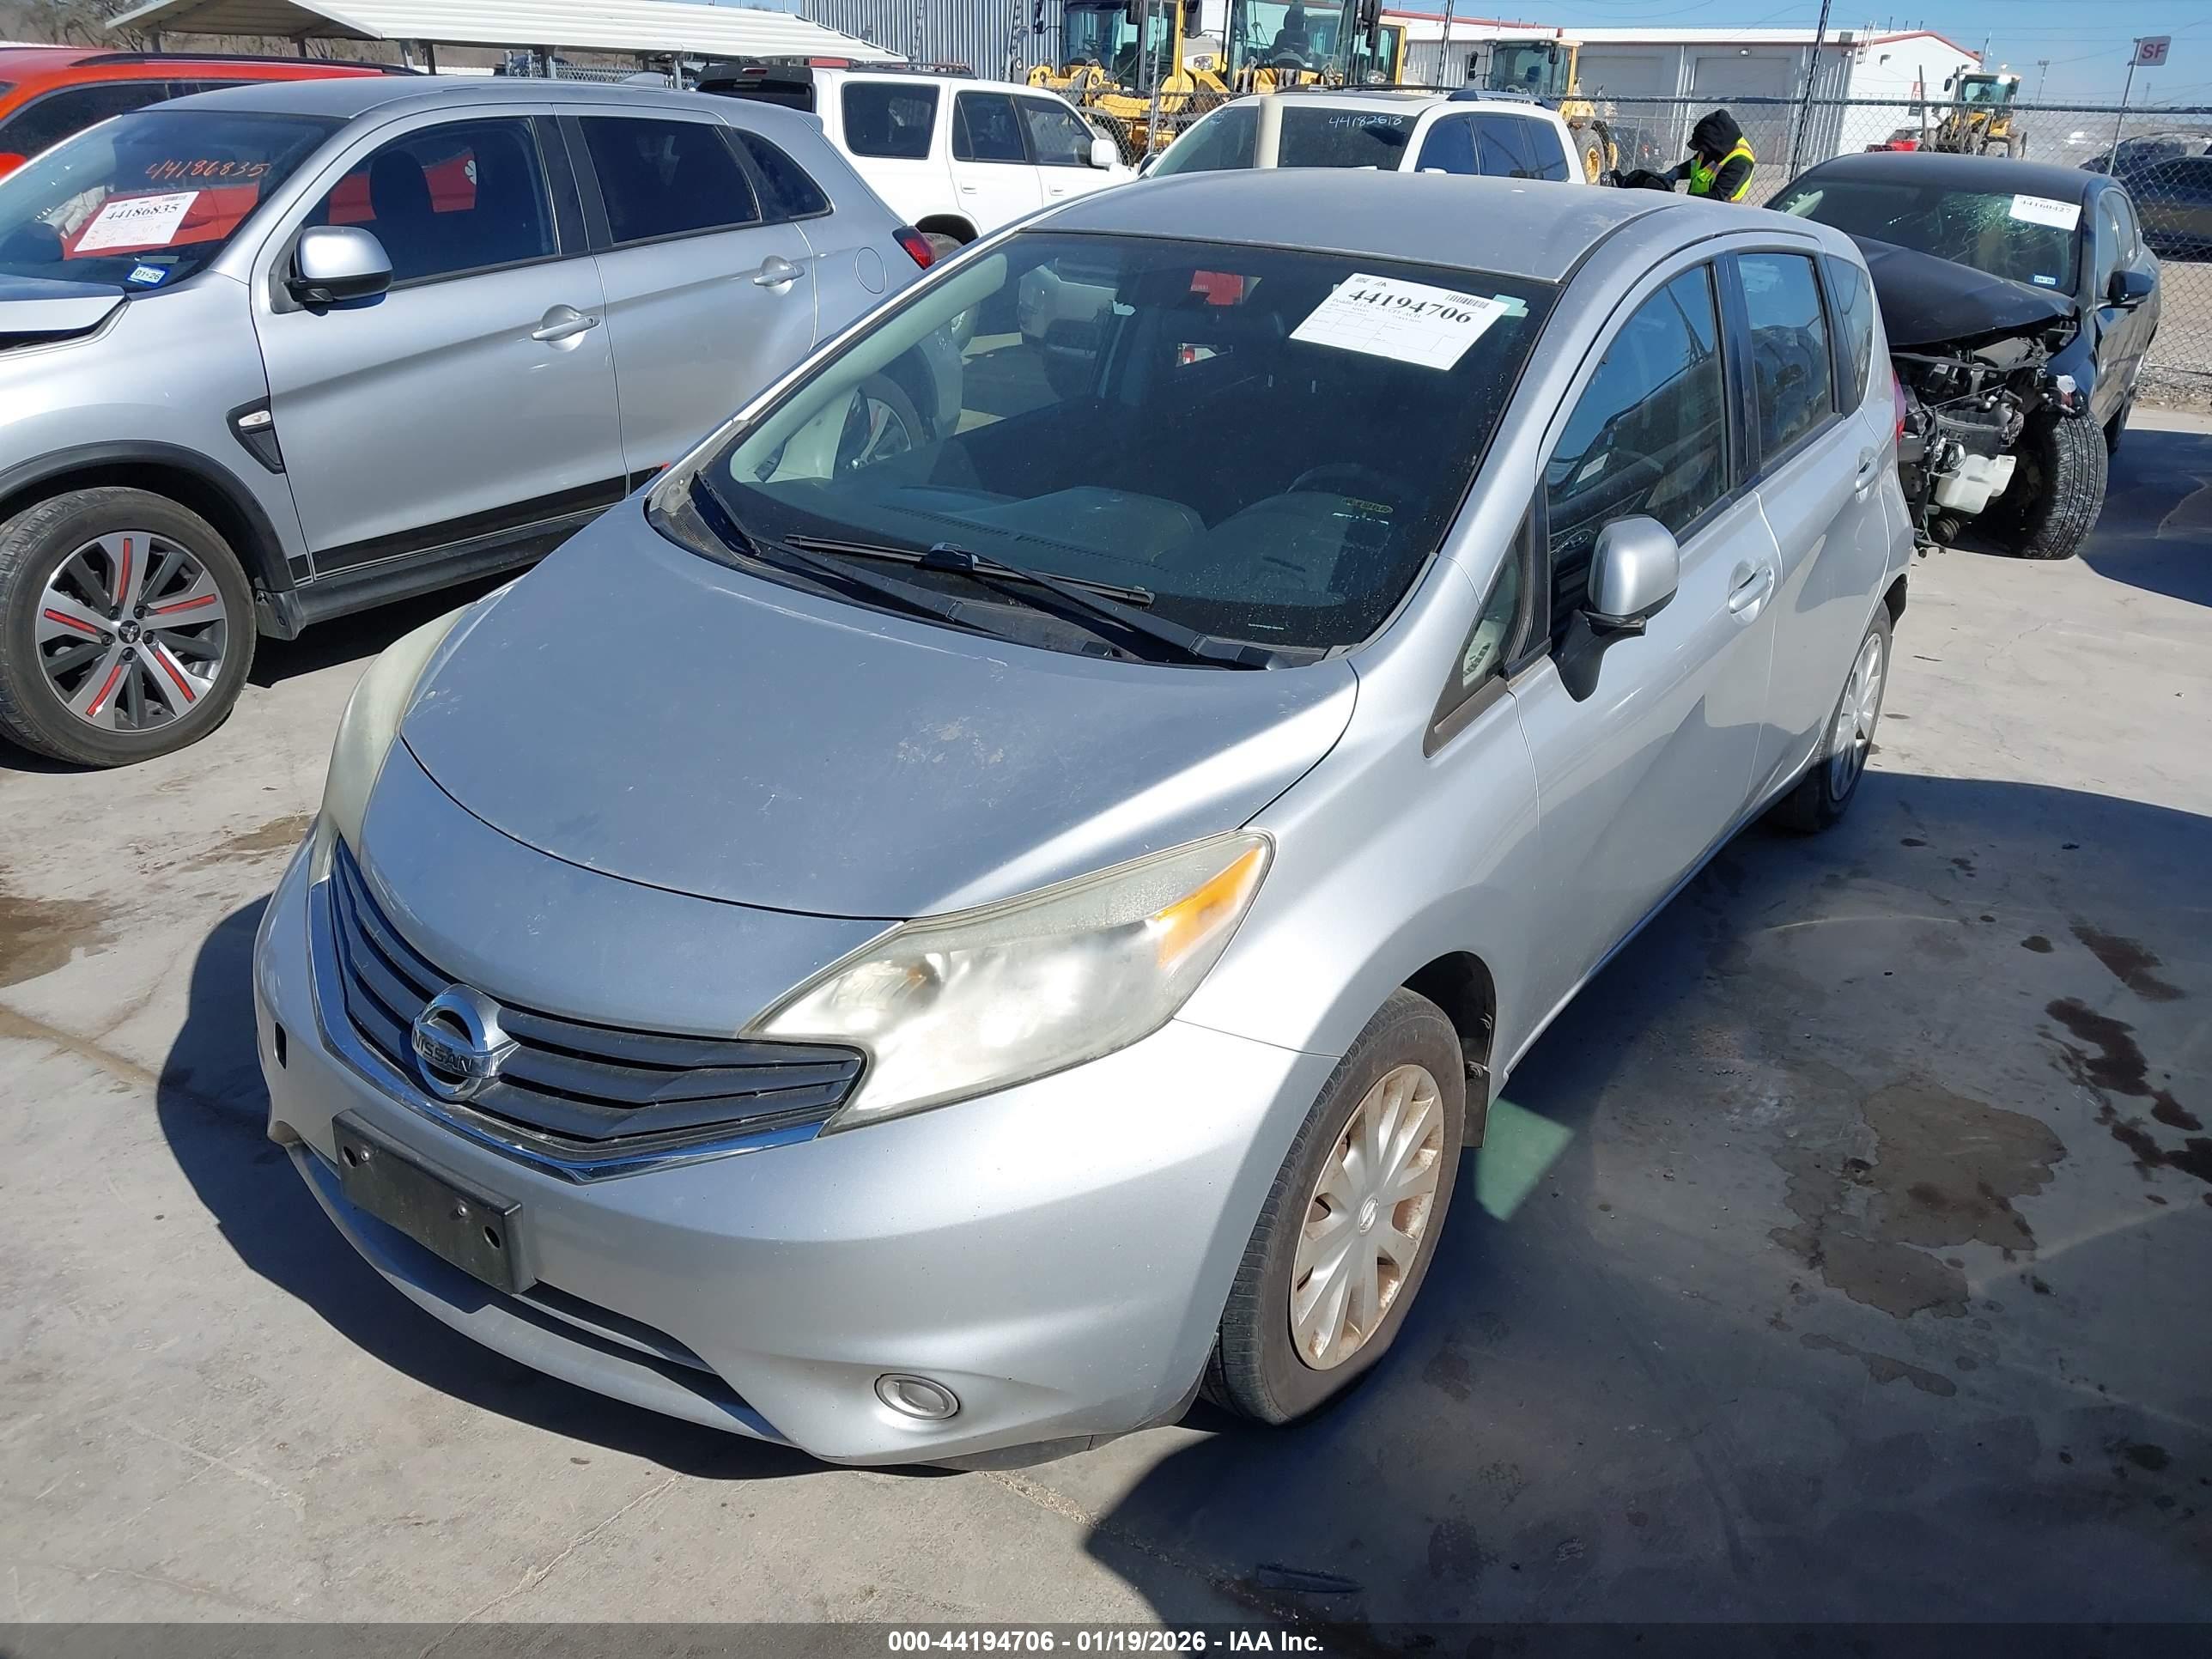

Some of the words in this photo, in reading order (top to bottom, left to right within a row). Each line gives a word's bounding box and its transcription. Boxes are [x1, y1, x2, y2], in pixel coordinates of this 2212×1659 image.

[2142, 44, 2166, 58] SF
[145, 160, 270, 179] 44186835
[106, 204, 179, 220] 44186835
[1348, 289, 1478, 324] 44194706
[412, 1030, 472, 1073] NISSAN
